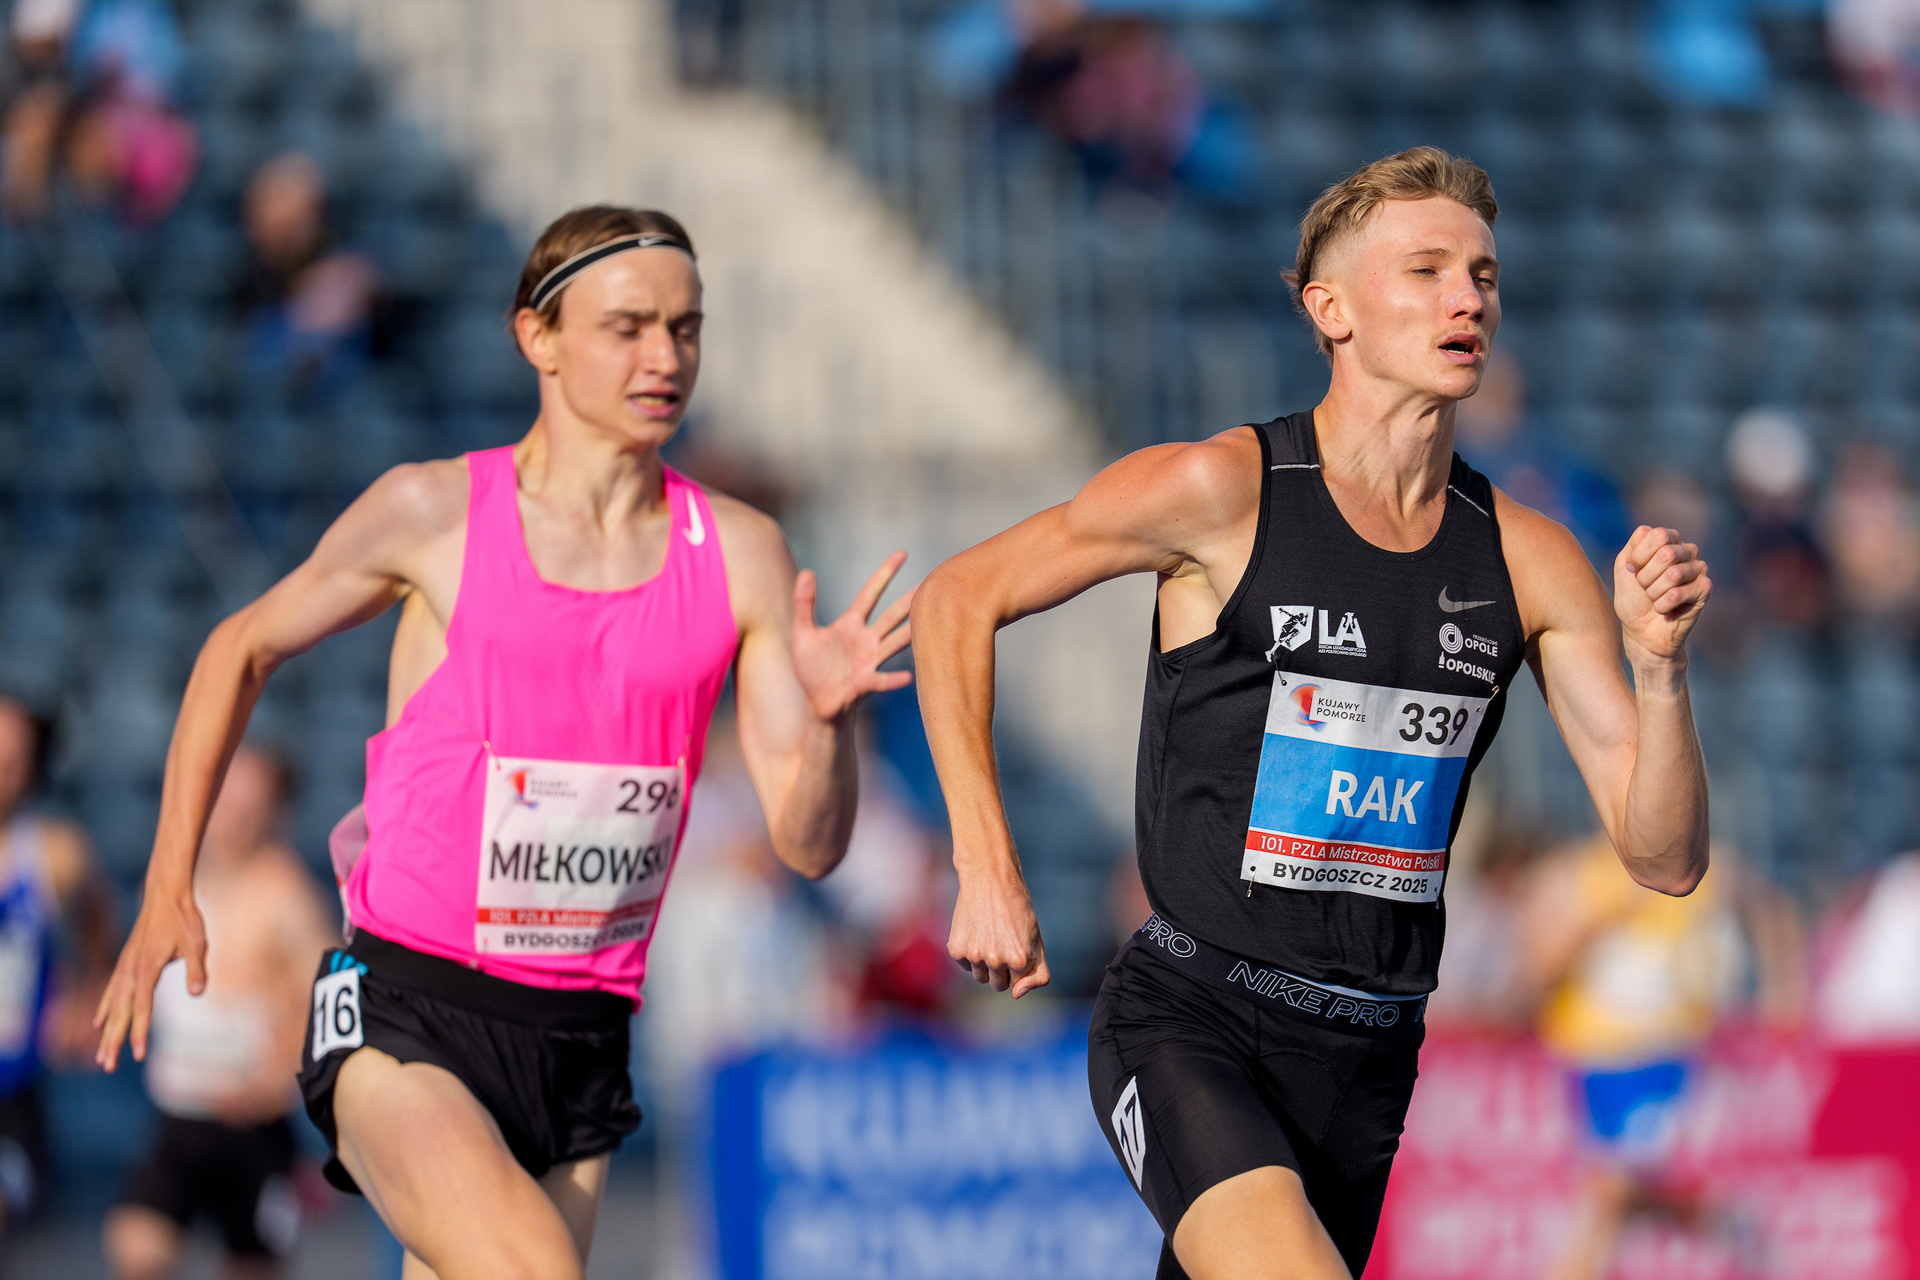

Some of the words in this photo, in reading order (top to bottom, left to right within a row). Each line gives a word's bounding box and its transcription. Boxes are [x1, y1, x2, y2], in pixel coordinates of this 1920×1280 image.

[1318, 609, 1367, 649] LA
[1464, 637, 1498, 657] OPOLE
[1446, 658, 1496, 684] OPOLSKIE
[1316, 708, 1367, 723] POMORZE
[1318, 697, 1360, 711] KUJAWY
[1399, 702, 1469, 746] 339
[1325, 769, 1425, 825] RAK
[1260, 835, 1286, 853] 101.
[1291, 841, 1326, 859] PZLA
[1329, 846, 1412, 869] Mistrzostwa
[1414, 855, 1440, 871] Polski
[1273, 862, 1387, 889] BYDGOSZCZ
[1389, 878, 1428, 894] 2025
[1227, 960, 1331, 1014] NIKE
[1326, 997, 1399, 1027] PRO
[316, 986, 355, 1044] 16
